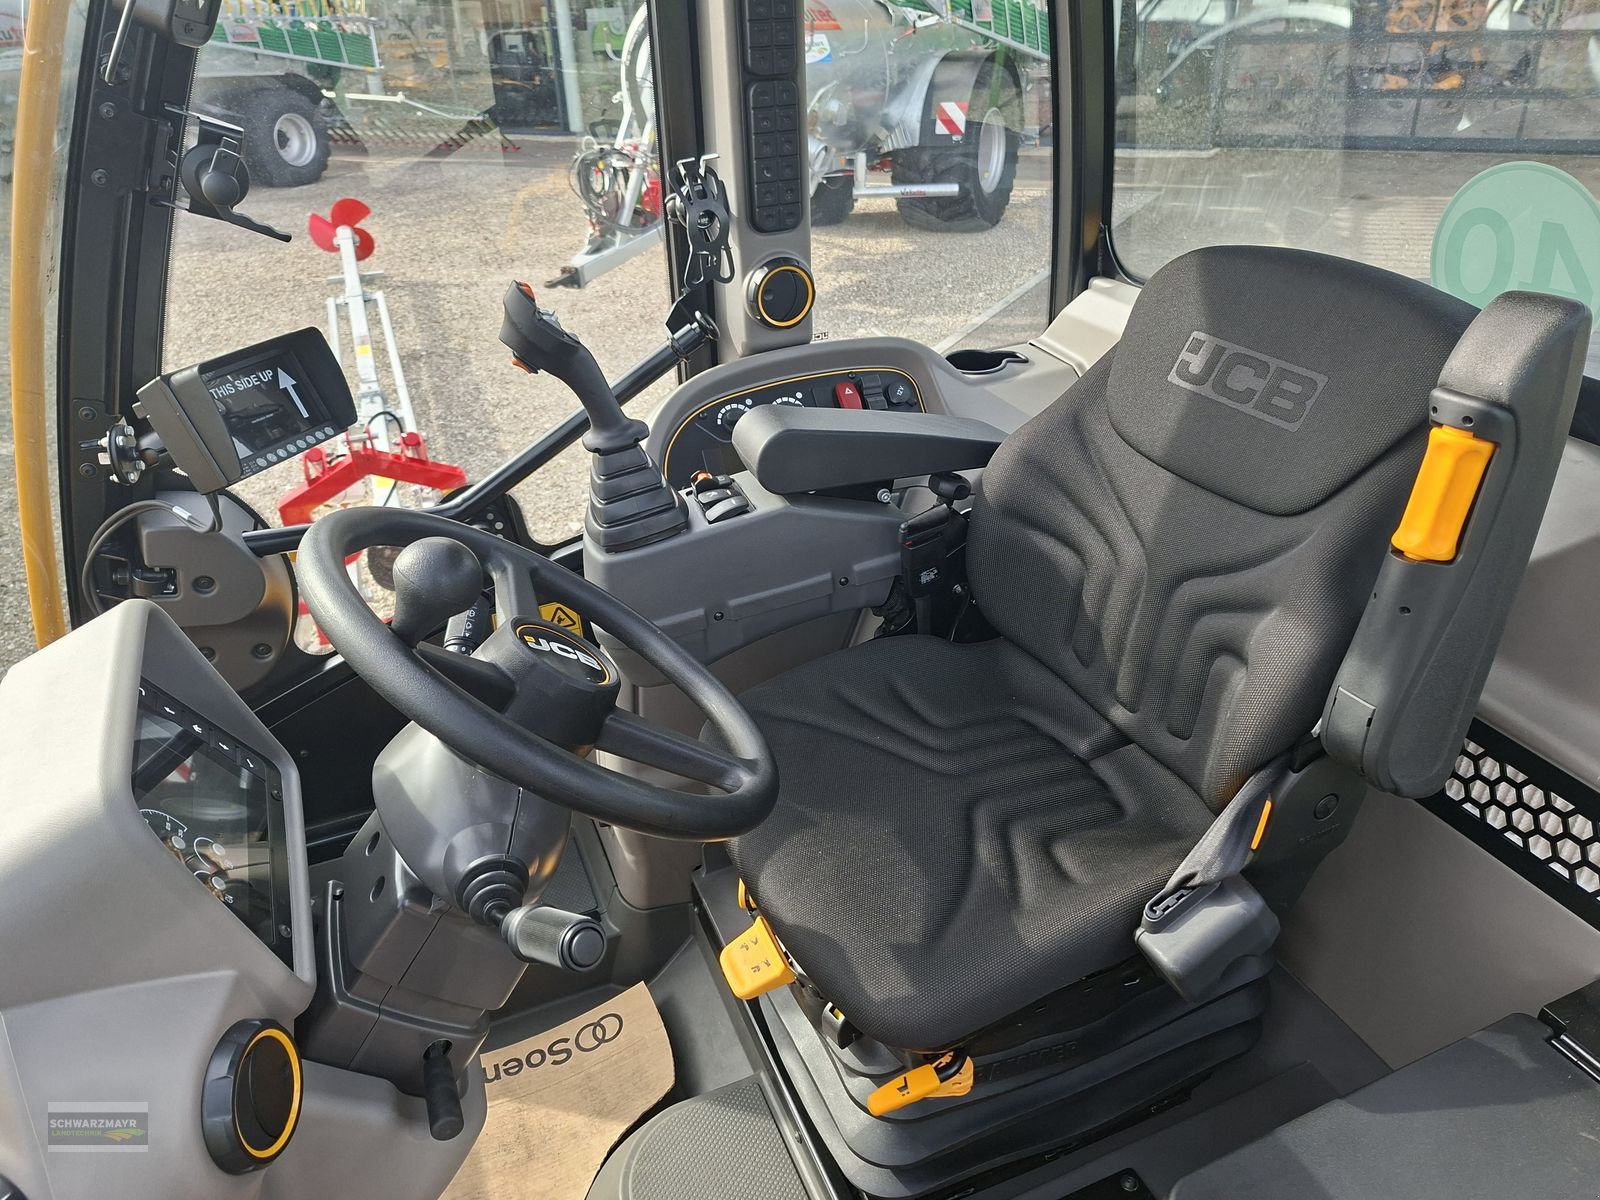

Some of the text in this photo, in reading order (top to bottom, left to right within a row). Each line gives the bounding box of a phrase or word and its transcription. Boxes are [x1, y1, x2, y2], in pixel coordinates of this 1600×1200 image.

[209, 369, 274, 400] THIS SIDE UP
[1175, 336, 1319, 424] JCB
[523, 635, 602, 671] JCB
